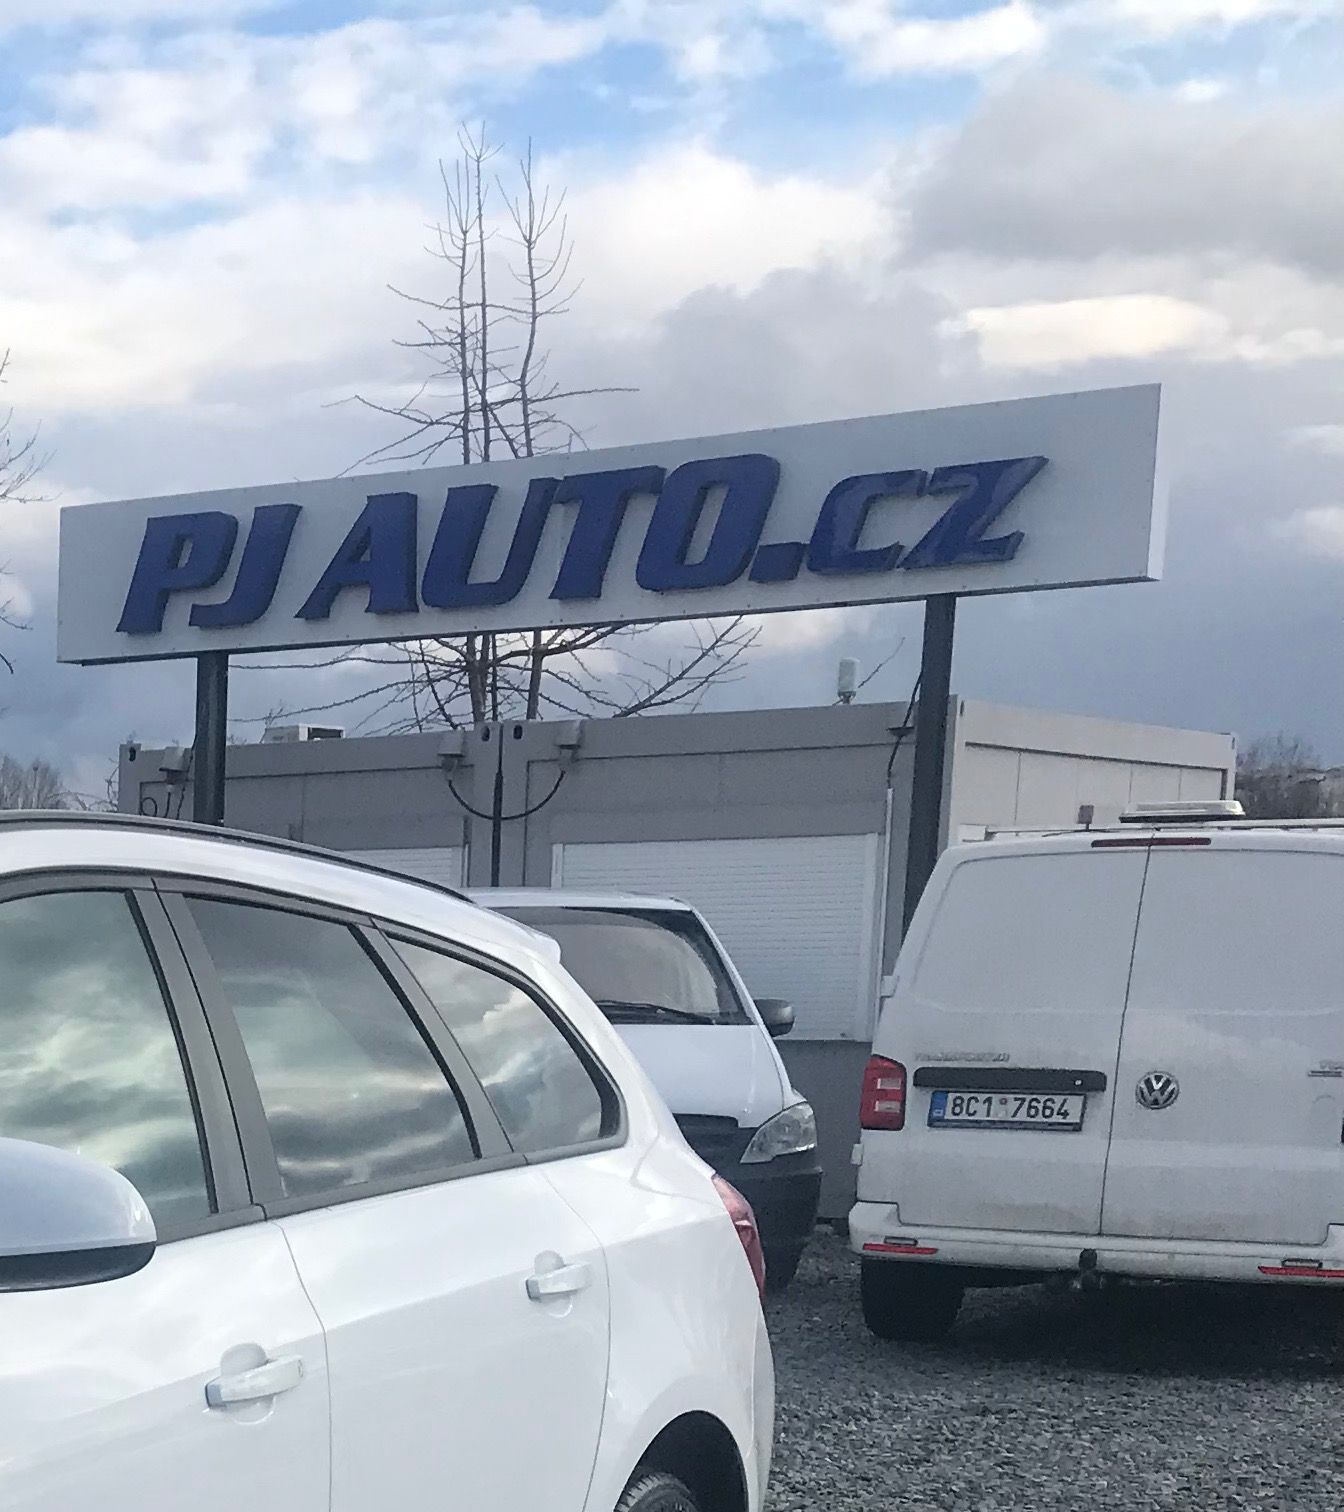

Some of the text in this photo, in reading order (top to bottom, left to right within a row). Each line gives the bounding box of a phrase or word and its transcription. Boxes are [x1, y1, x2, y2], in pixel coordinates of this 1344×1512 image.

[1135, 1071, 1180, 1111] VW
[950, 1095, 1070, 1120] 8C1 7664
